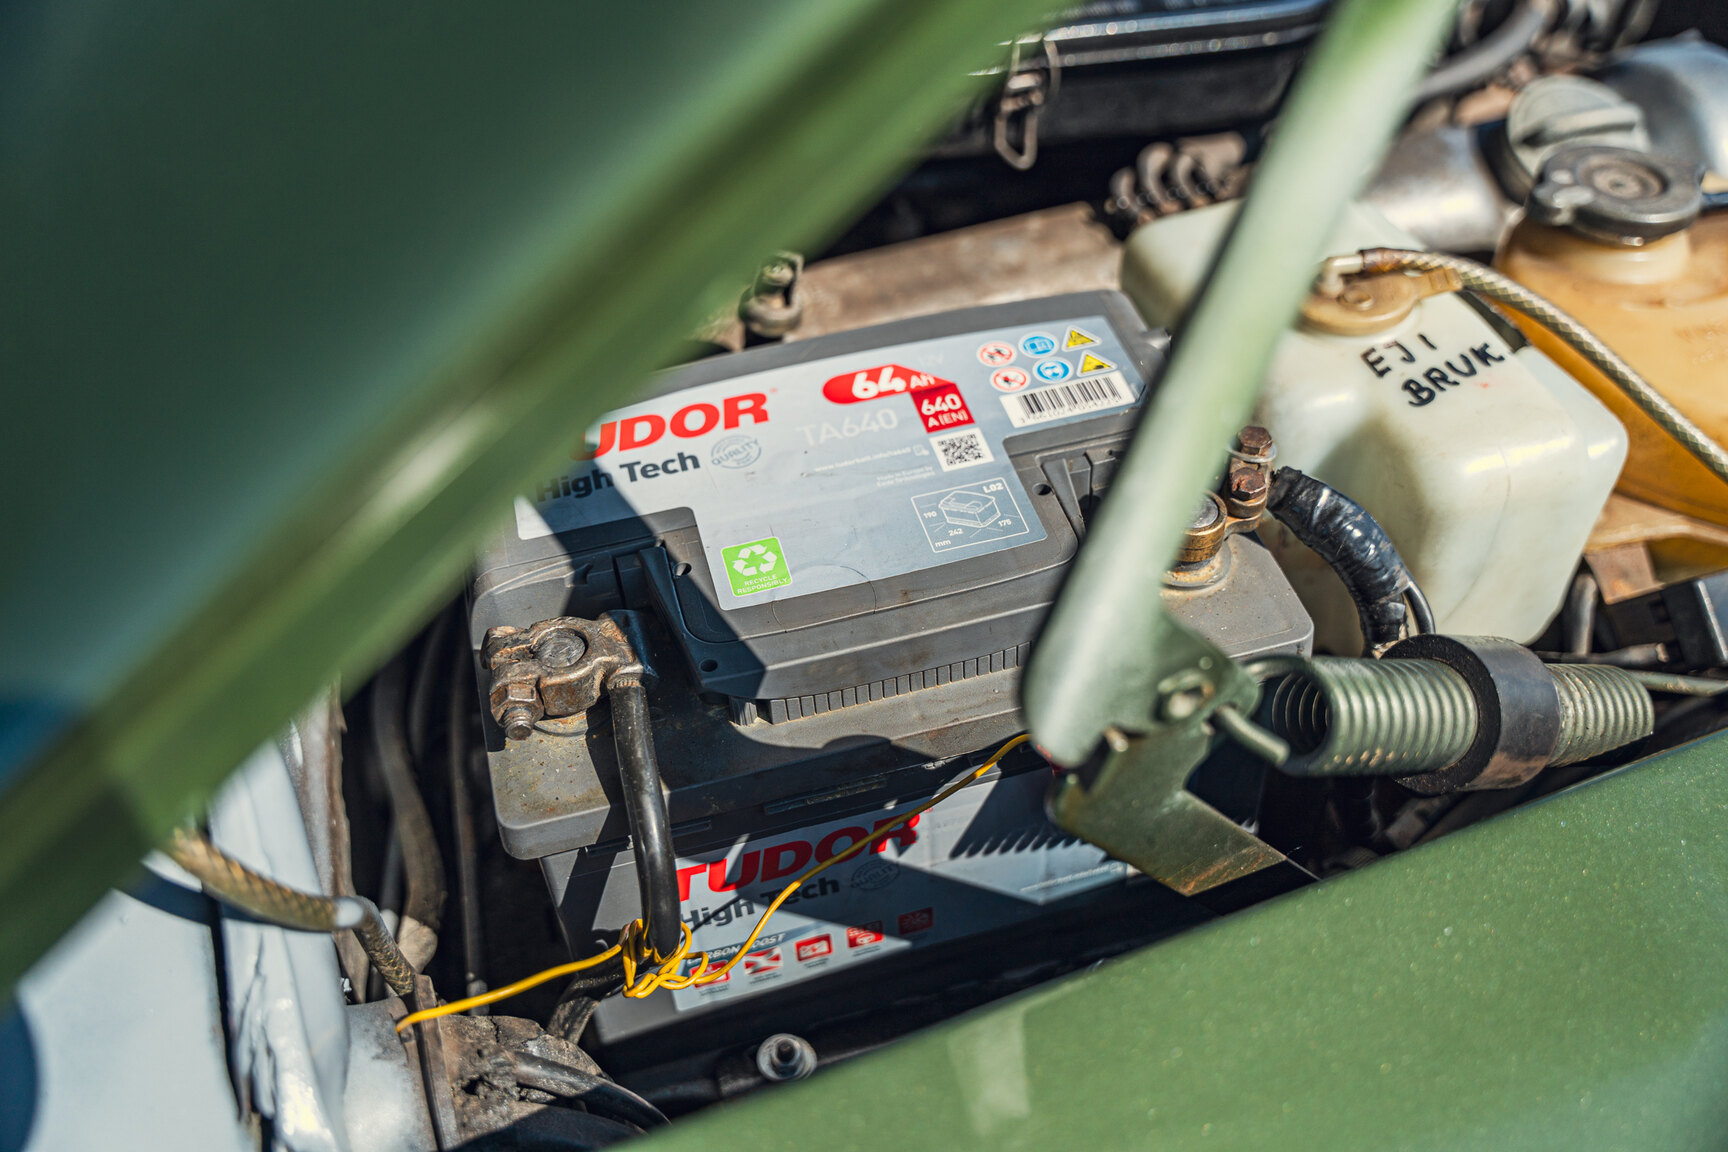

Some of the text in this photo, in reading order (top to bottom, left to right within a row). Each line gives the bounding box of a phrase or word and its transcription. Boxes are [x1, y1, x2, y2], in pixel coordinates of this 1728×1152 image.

[852, 366, 936, 399] 64 Ah
[1401, 342, 1506, 407] BRUK
[921, 393, 962, 416] 640
[569, 393, 769, 461] UDOR
[796, 408, 898, 446] TA640
[927, 416, 940, 428] A
[711, 438, 760, 466] QUALITY
[536, 452, 701, 501] High Tech
[923, 510, 938, 519] 190
[934, 540, 952, 548] mm
[948, 528, 964, 536] 242
[744, 573, 777, 587] RECYCLE
[676, 814, 920, 902] TUDOR
[681, 897, 755, 927] High
[752, 933, 786, 949] OOST
